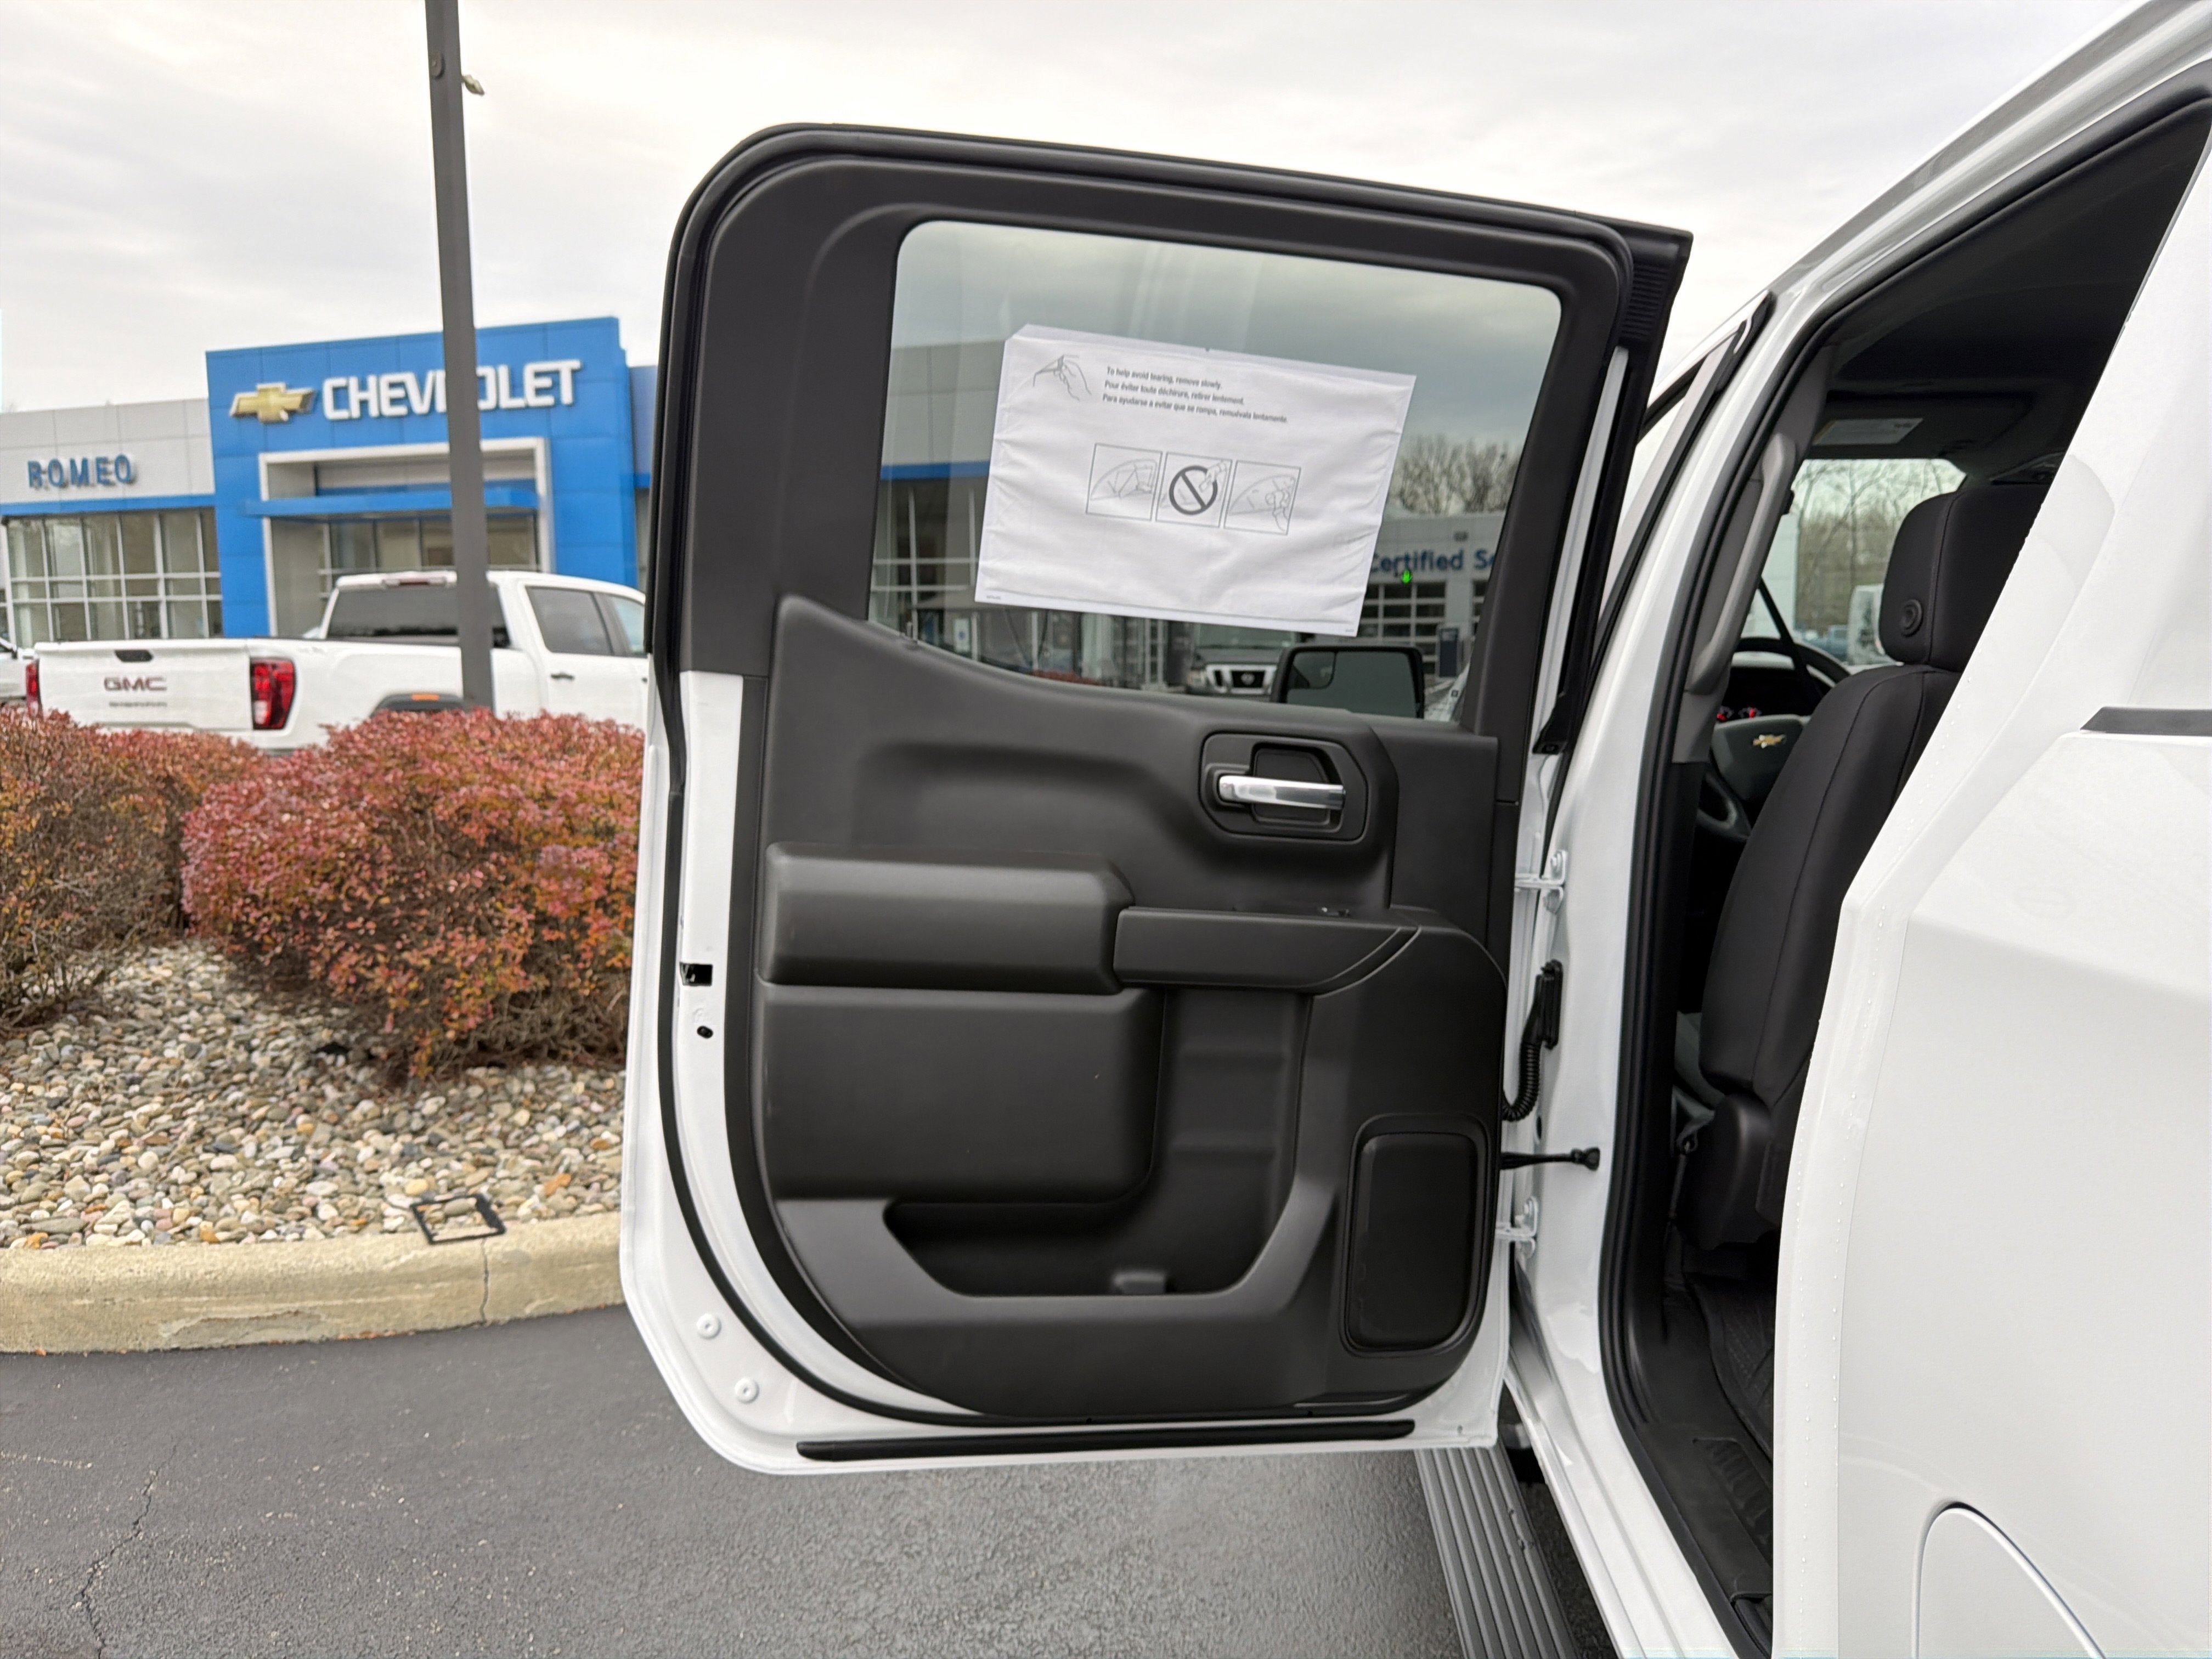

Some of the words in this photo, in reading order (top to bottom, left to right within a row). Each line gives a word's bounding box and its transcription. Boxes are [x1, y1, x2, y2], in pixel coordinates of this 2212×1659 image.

[1107, 366, 1115, 375] To
[1116, 368, 1130, 377] help
[1131, 371, 1149, 380] avoid
[1150, 373, 1174, 384] tearing,
[1176, 377, 1200, 386] remove
[1104, 380, 1119, 388] Pour
[1141, 385, 1156, 394] toute
[1103, 393, 1117, 402] Para
[1154, 401, 1172, 409] evitar
[1173, 403, 1186, 411] que
[27, 453, 131, 487] ROMEO
[104, 676, 167, 691] GMC
